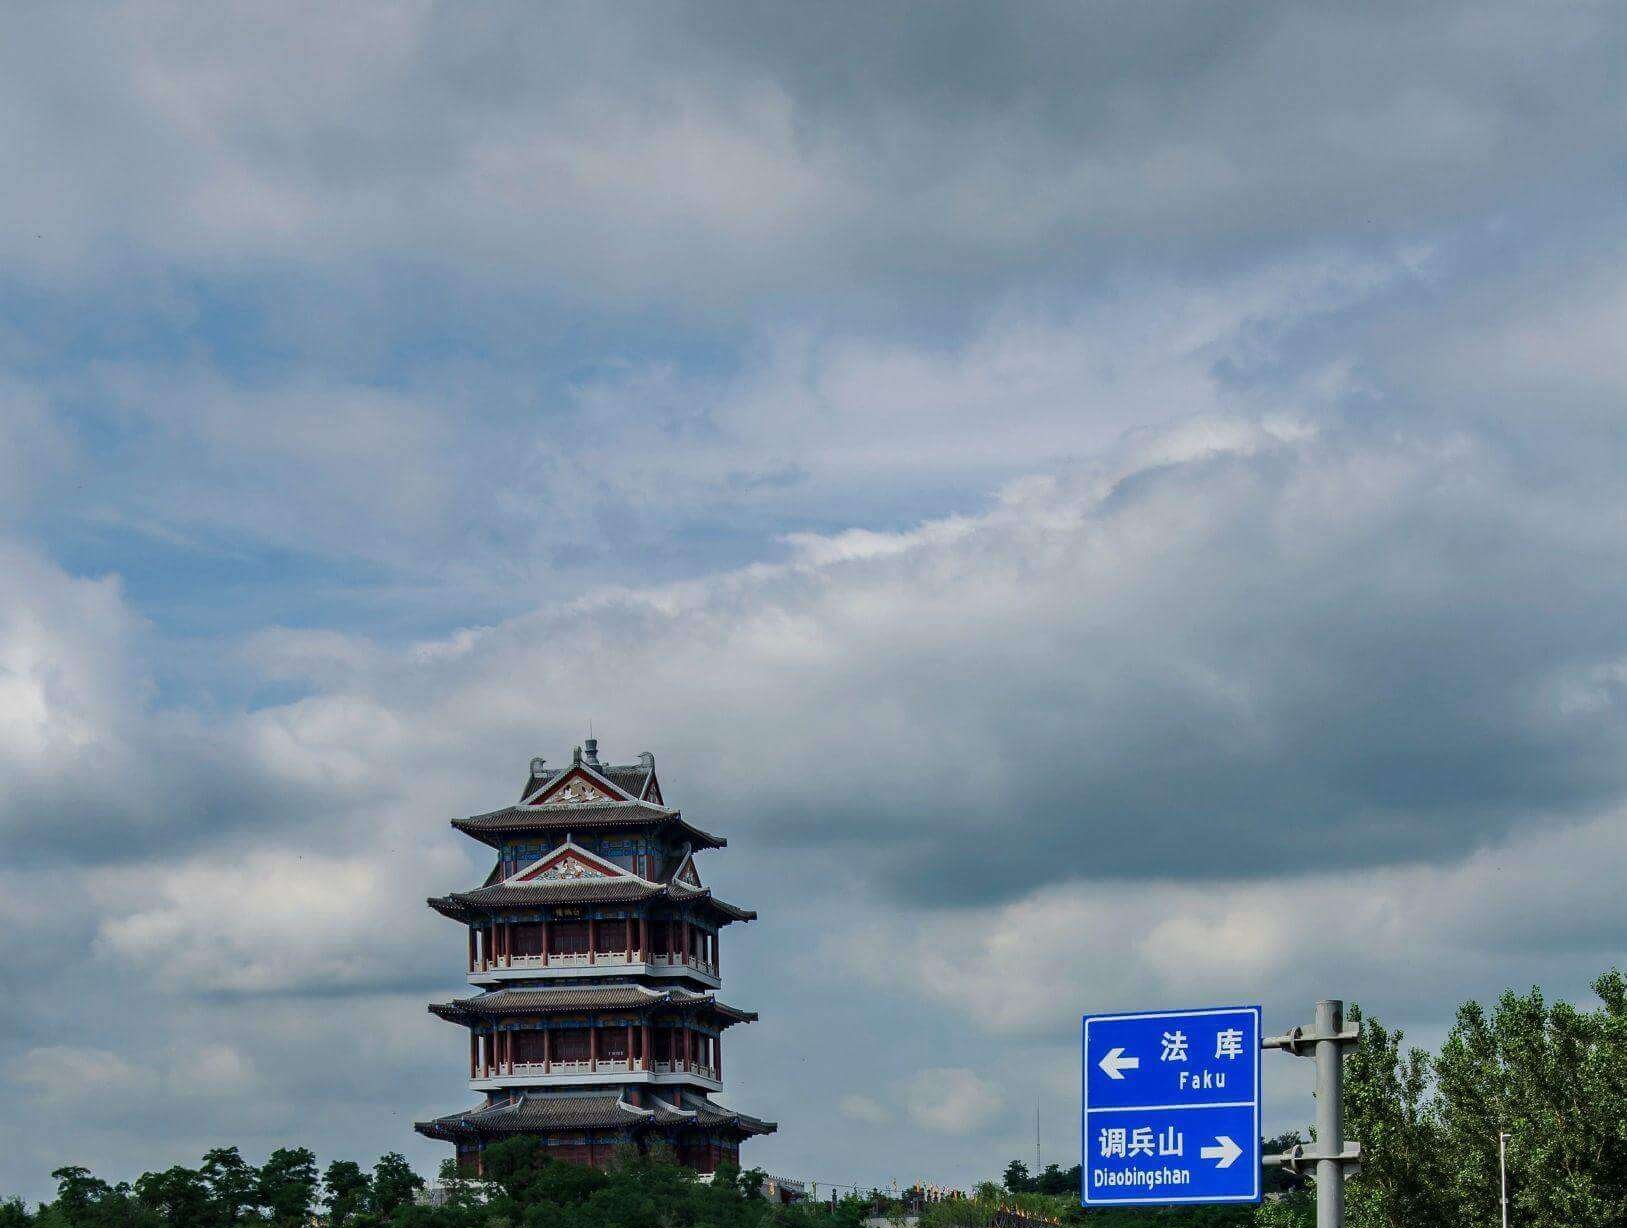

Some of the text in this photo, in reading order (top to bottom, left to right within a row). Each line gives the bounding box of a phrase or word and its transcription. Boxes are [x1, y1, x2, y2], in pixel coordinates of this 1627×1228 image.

[1160, 1028, 1244, 1062] 法库
[1179, 1070, 1226, 1090] Faku
[1098, 1126, 1184, 1159] 调兵山
[1094, 1167, 1190, 1190] Diaobingshan
